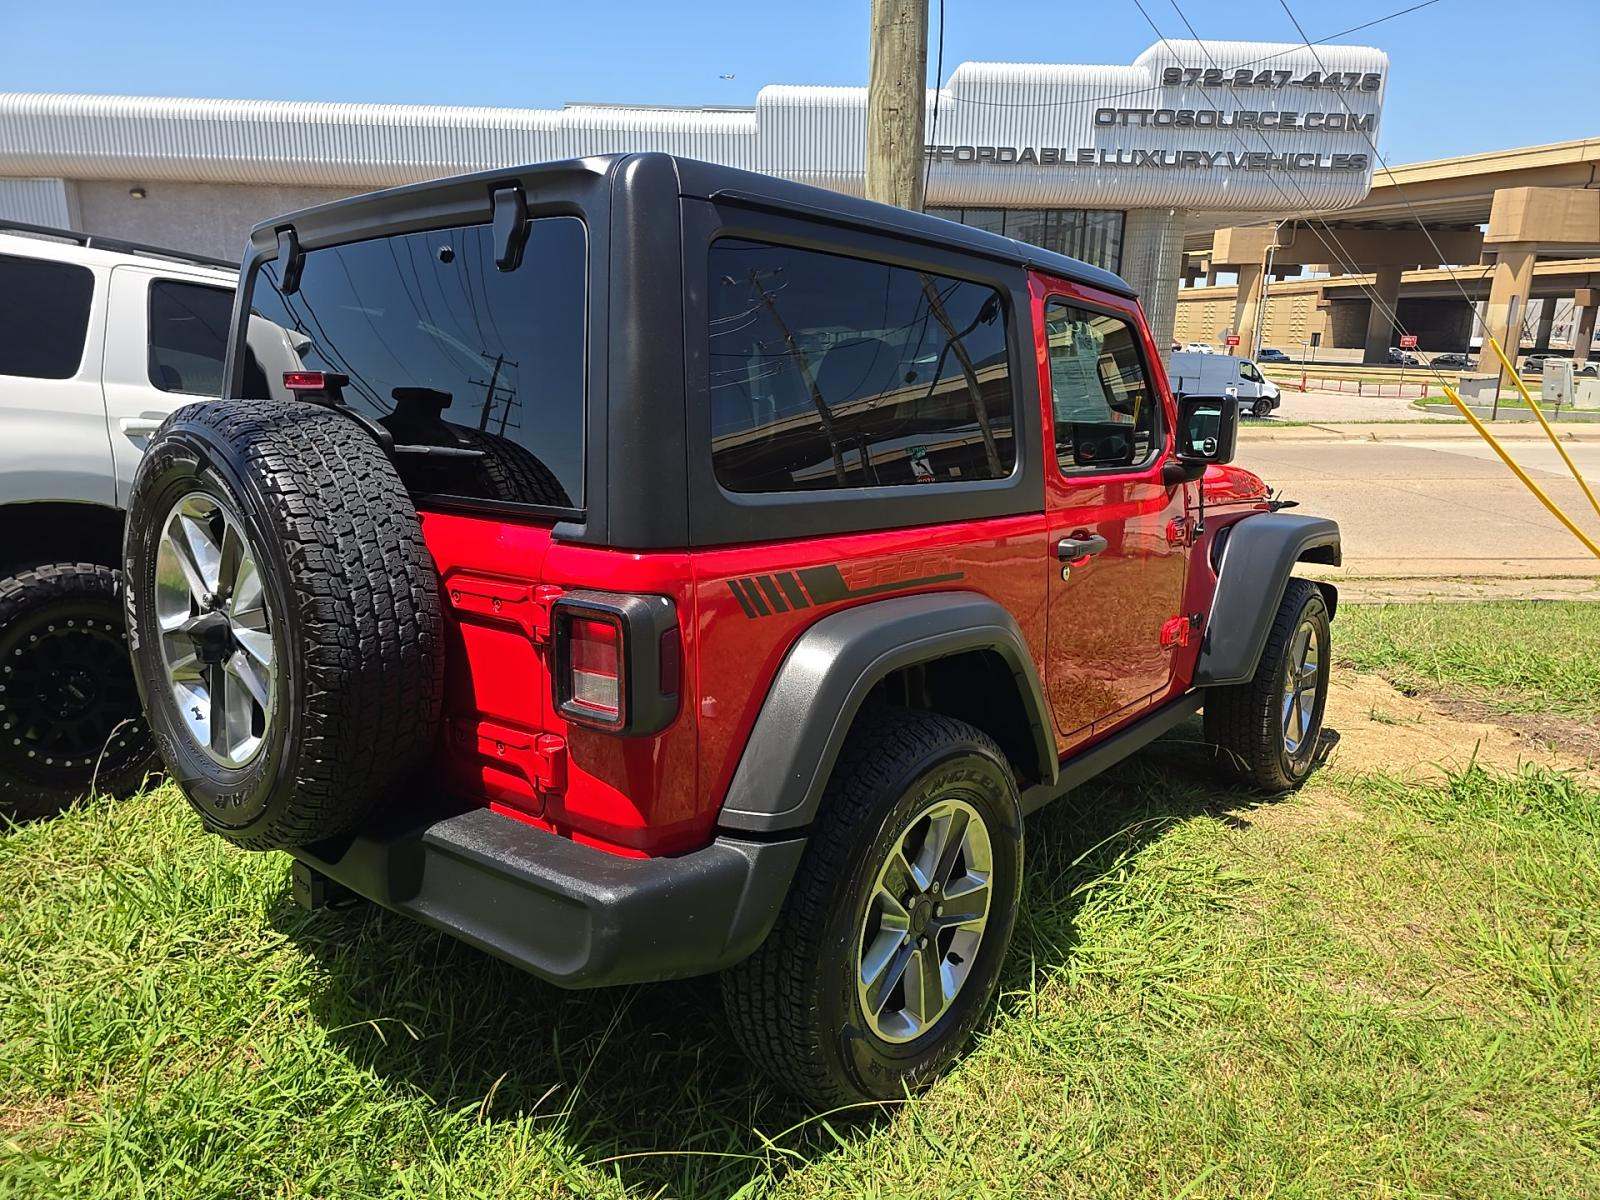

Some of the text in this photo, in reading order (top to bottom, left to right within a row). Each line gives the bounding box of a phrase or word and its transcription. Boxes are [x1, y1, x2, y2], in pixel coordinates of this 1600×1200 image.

[1162, 66, 1382, 92] 972-247-4476
[1094, 107, 1375, 132] OTTOSOURCE.COM
[923, 144, 1368, 172] FFORDABLE LUXURY VEHICLES
